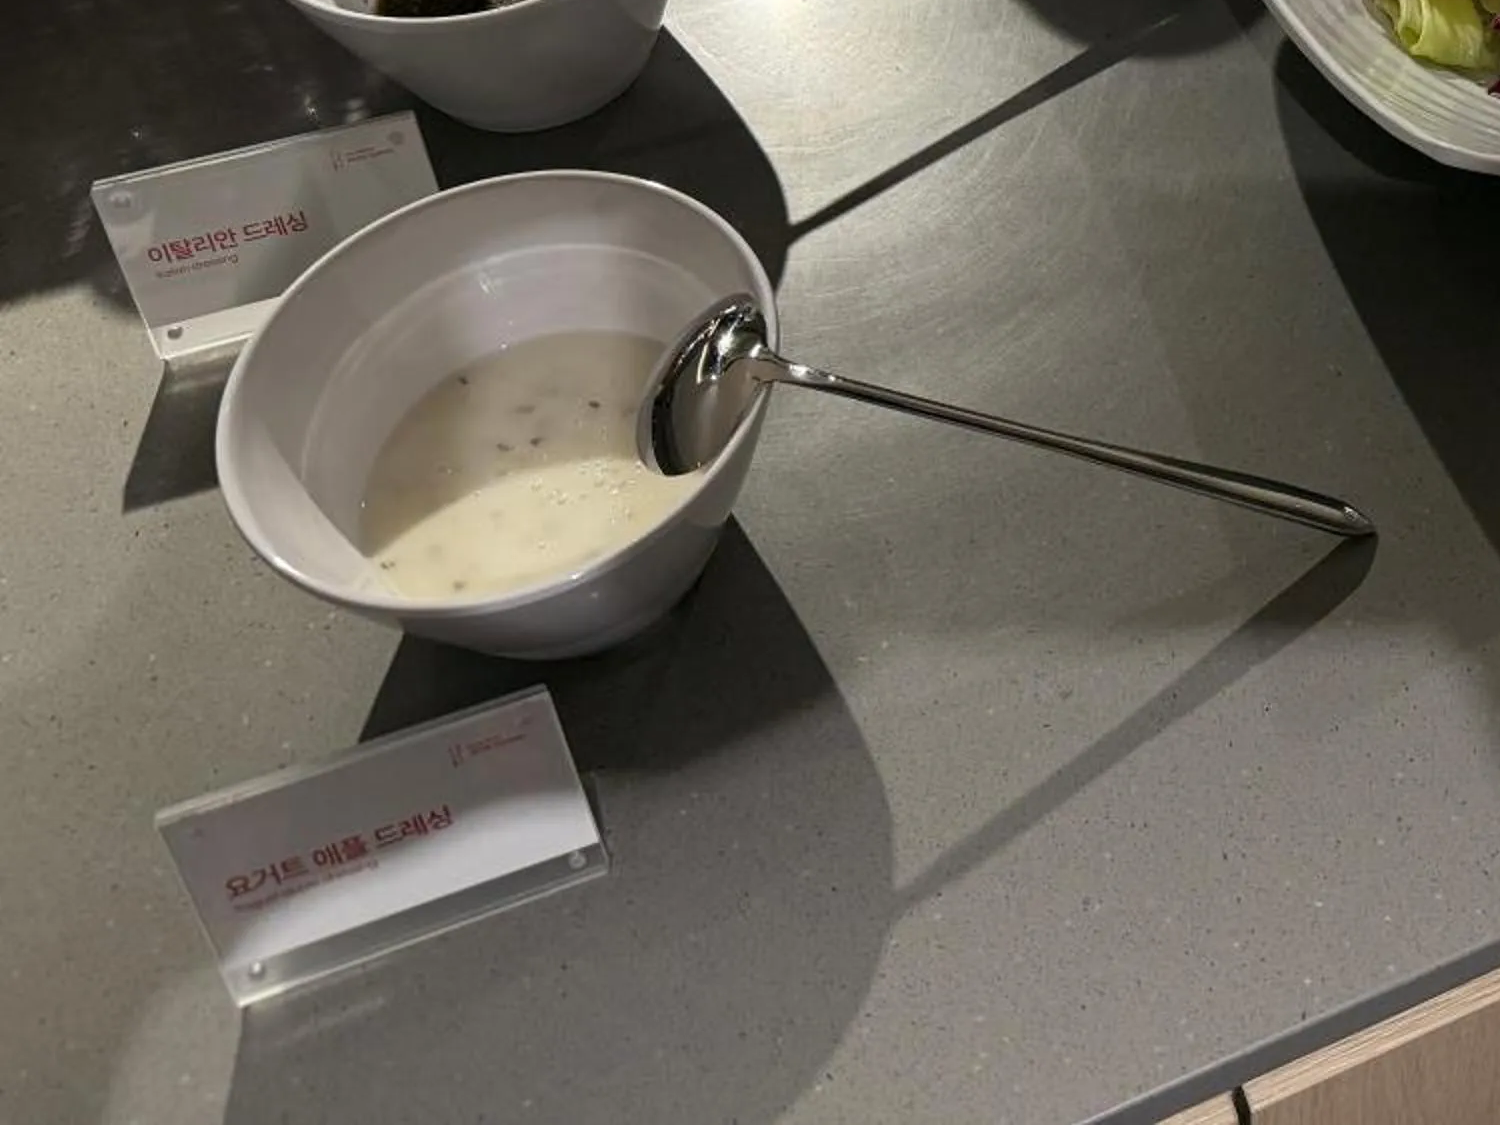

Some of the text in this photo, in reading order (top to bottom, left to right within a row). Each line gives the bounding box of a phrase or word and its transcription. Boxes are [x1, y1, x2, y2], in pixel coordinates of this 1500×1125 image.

[148, 211, 309, 263] 이탈리안 드레싱
[225, 855, 310, 897] 요거트
[312, 834, 369, 867] 애플
[373, 804, 454, 849] 드레싱
